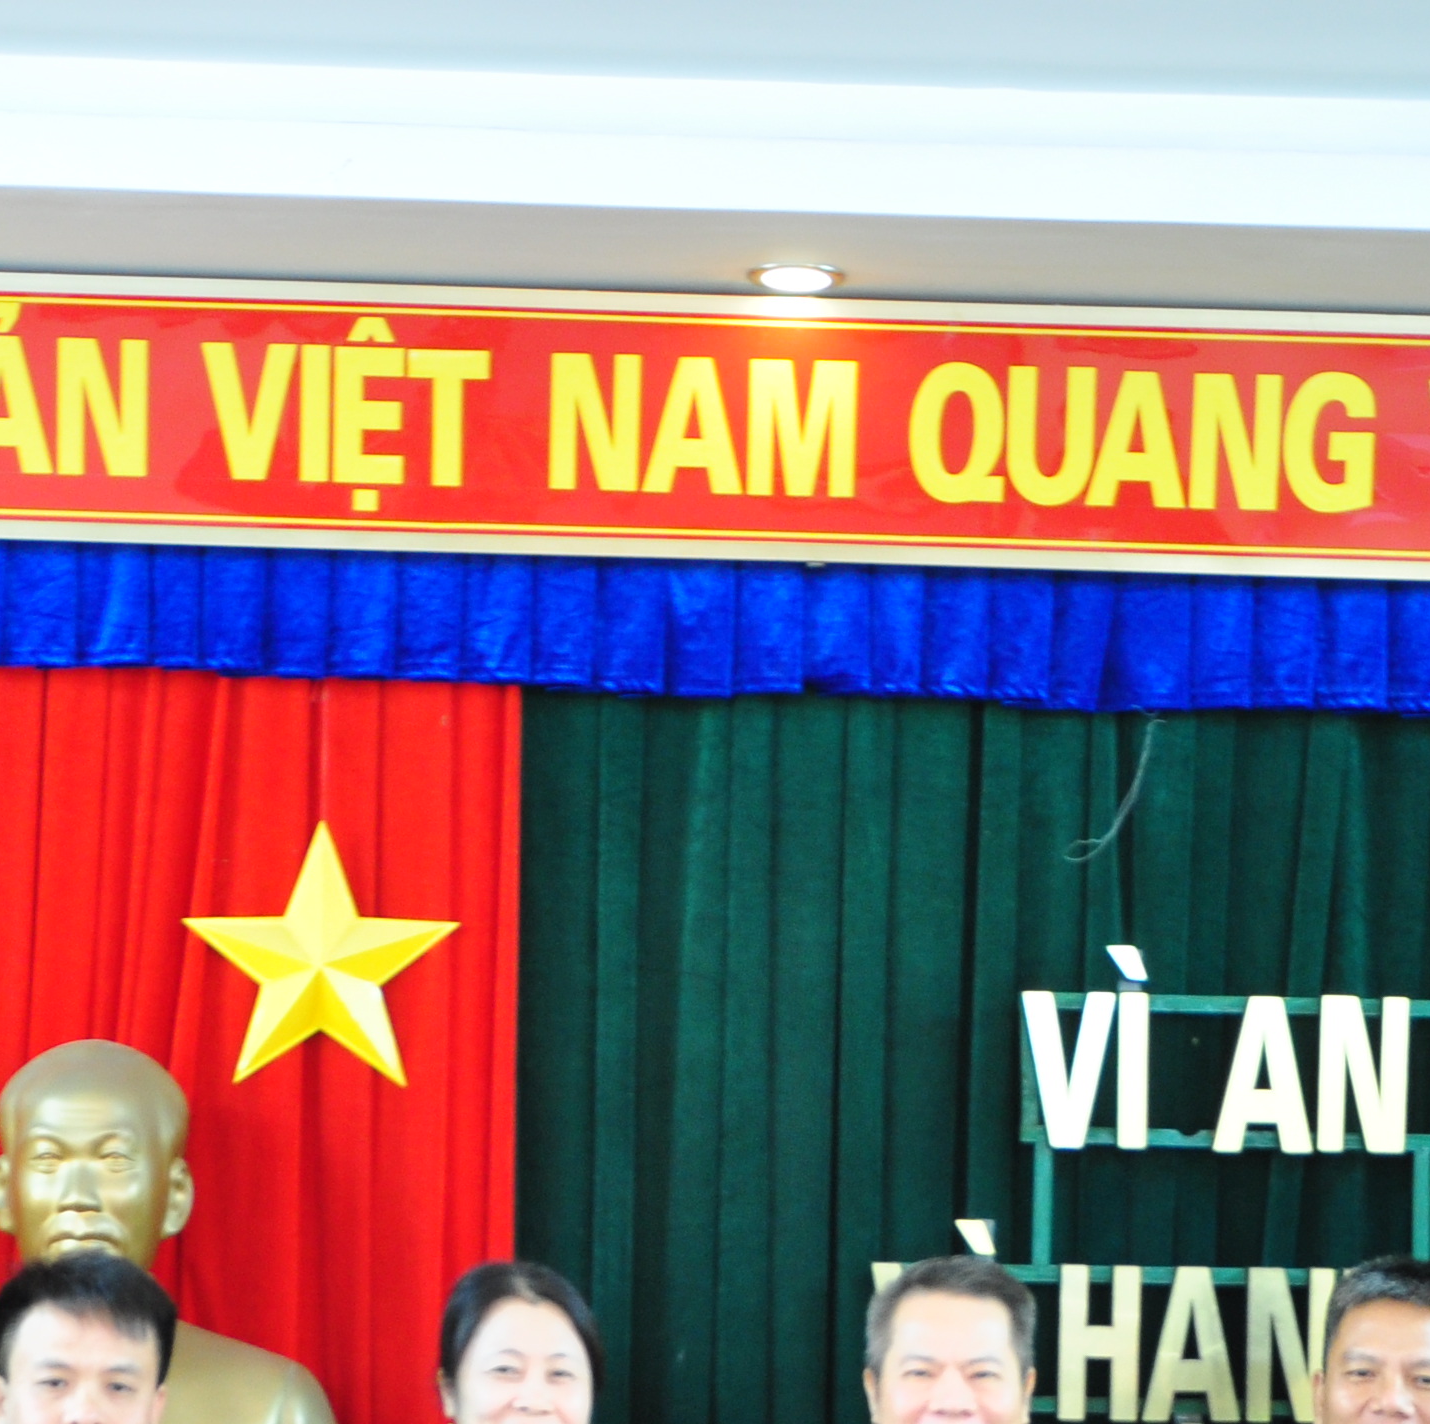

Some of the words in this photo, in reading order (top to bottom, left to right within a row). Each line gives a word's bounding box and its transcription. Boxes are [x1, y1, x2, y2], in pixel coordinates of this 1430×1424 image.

[201, 316, 491, 512] VIỆT
[547, 353, 859, 498] NAM
[908, 361, 1376, 513] QUANG
[1021, 945, 1150, 1150] VÌ
[1211, 994, 1411, 1154] AN
